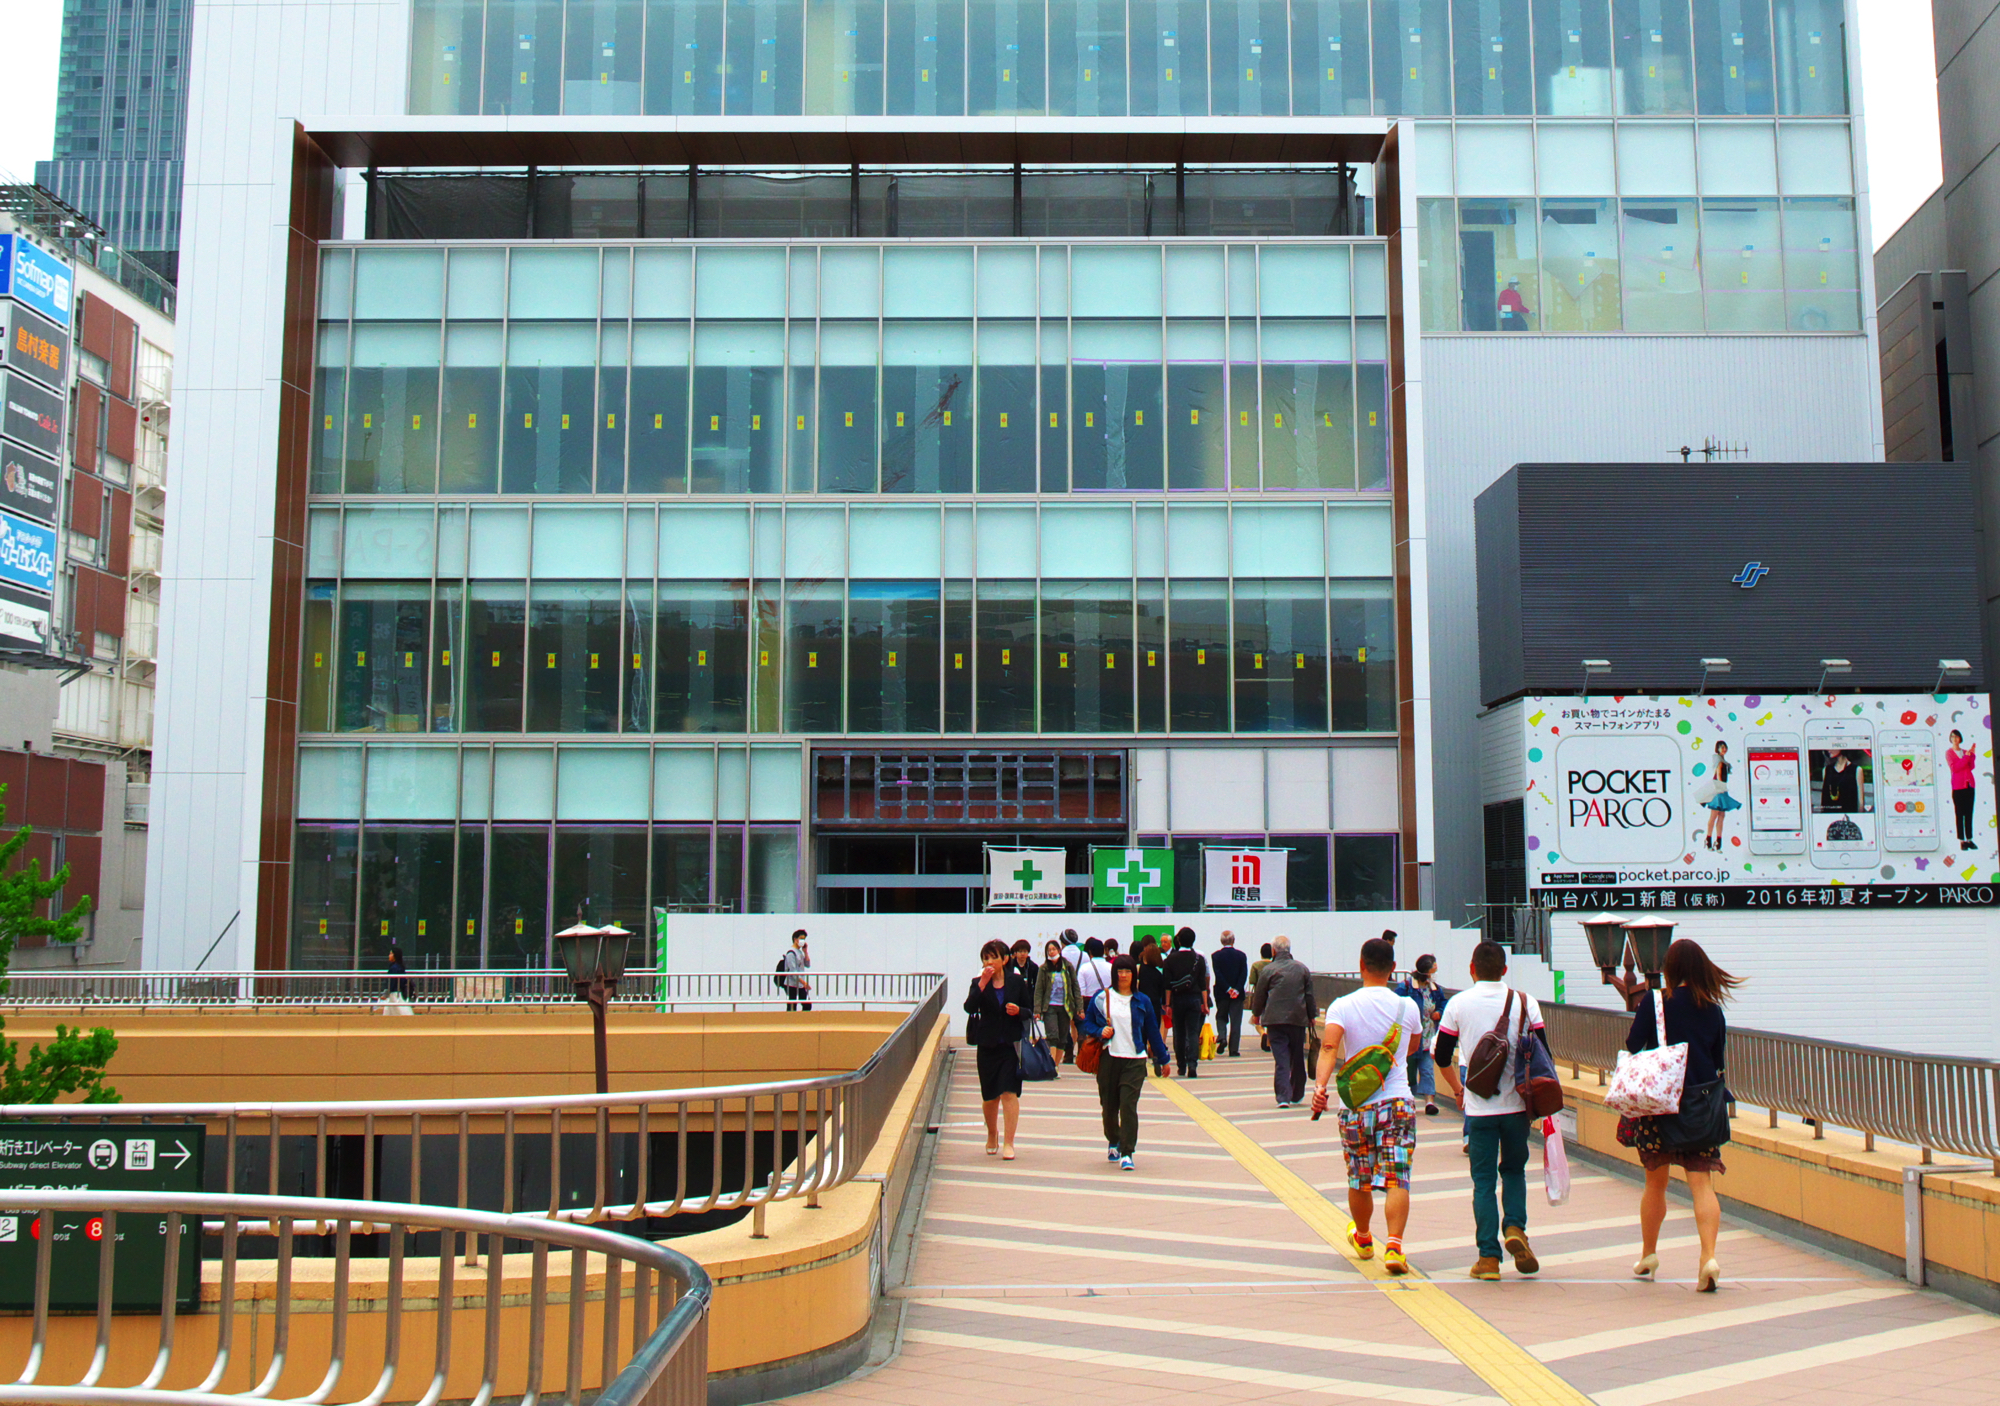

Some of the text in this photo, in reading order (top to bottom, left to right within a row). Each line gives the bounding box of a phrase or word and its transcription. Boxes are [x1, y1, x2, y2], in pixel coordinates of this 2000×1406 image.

[16, 251, 54, 296] Sofmap
[16, 326, 60, 371] 島村楽器
[1561, 708, 1671, 719] お買い物でコインがたまる
[1574, 720, 1660, 730] スマートフォンアプリ
[1568, 769, 1671, 794] POCKET
[1569, 797, 1672, 829] PARCO
[1619, 868, 1730, 883] pocket.parco.jp
[1231, 886, 1260, 901] 鹿島
[1746, 887, 1928, 905] 2016年初夏オープン
[1939, 886, 1994, 904] PARCO
[0, 1161, 83, 1170] Subway direct Elevator
[91, 1221, 102, 1236] 8
